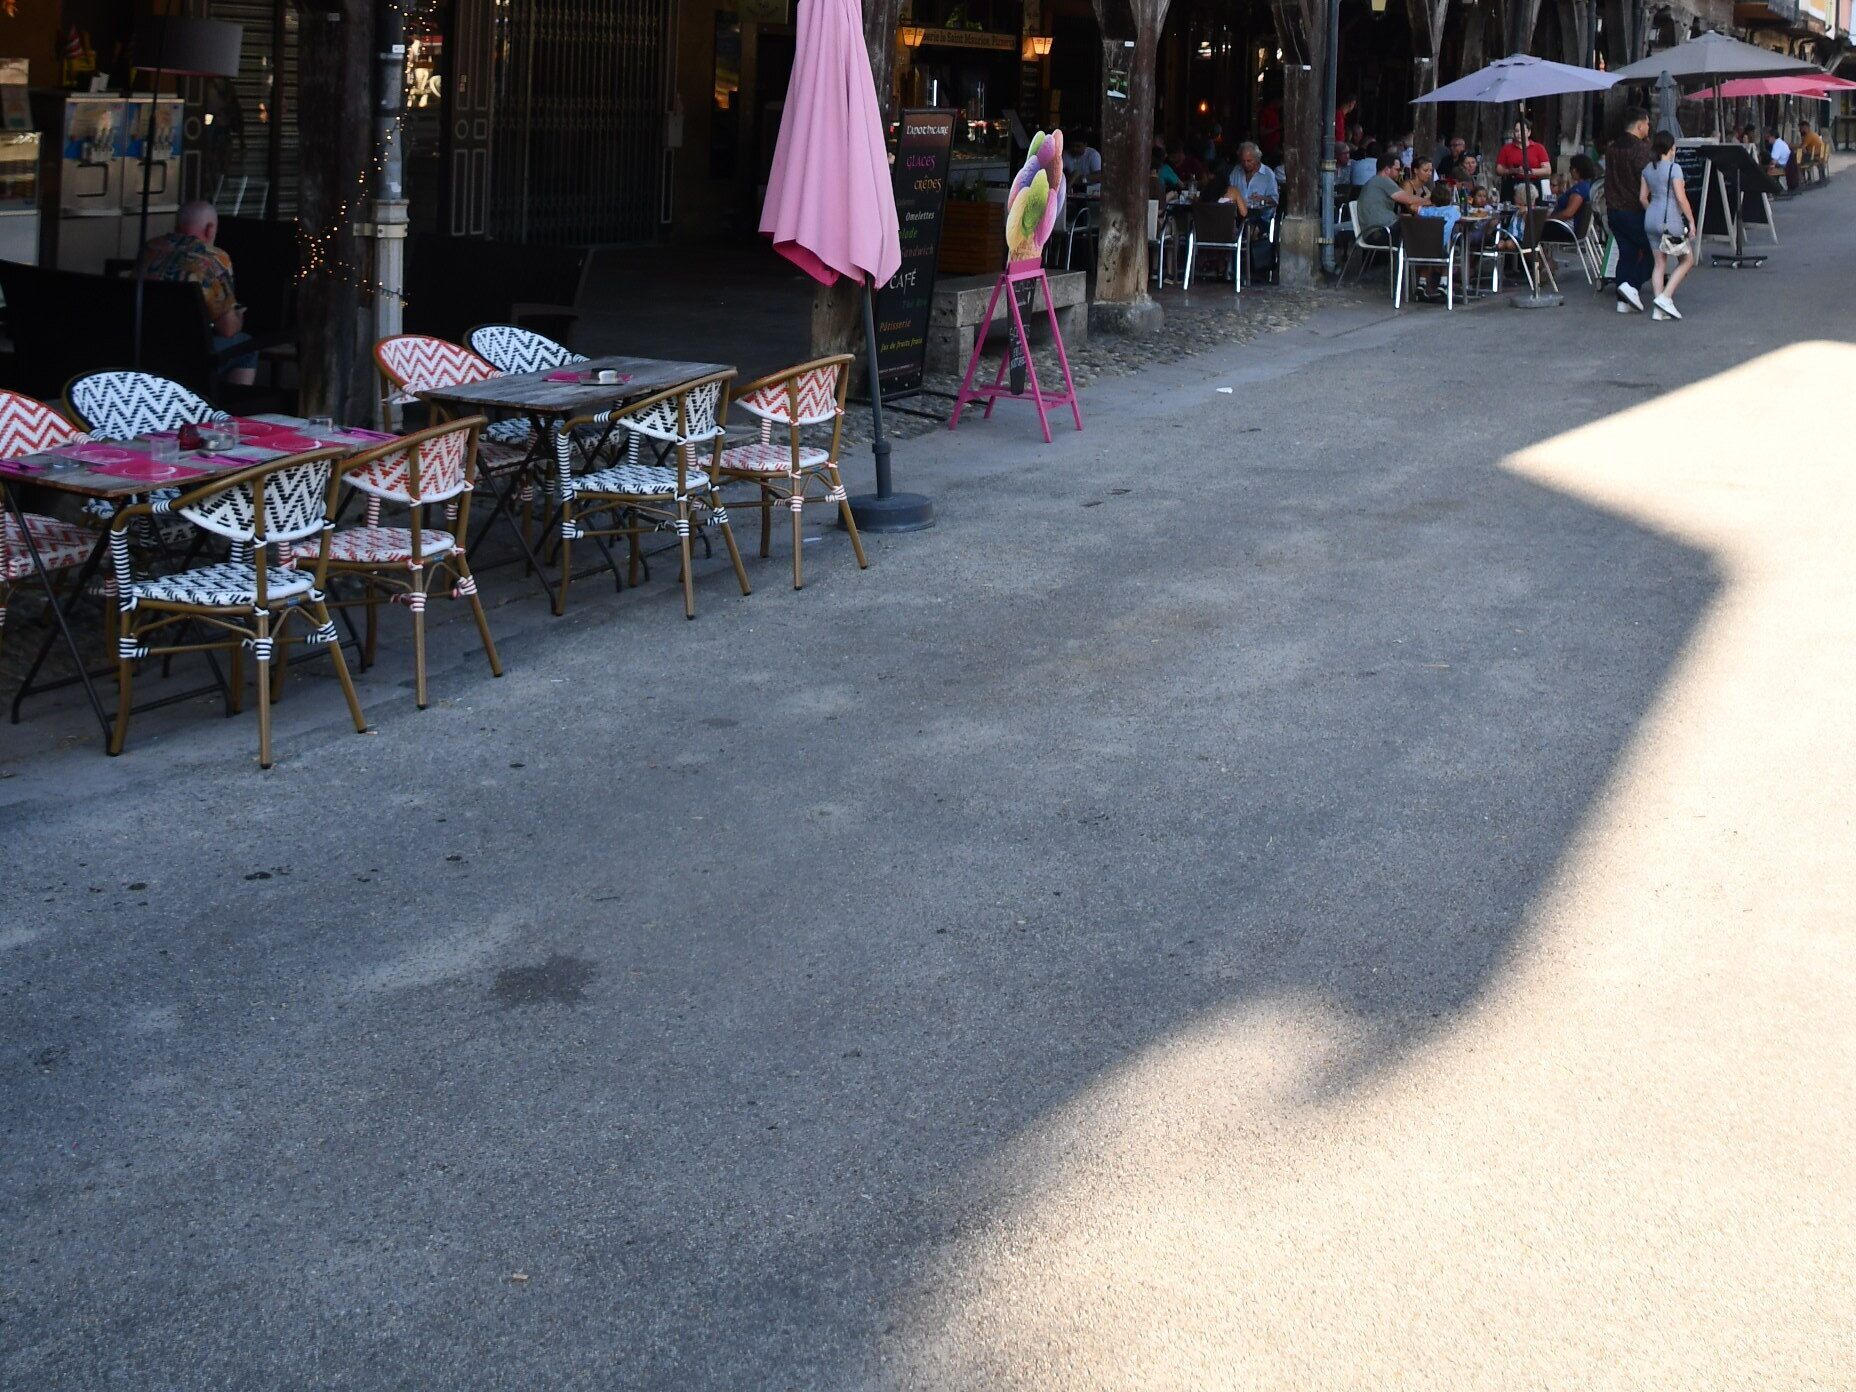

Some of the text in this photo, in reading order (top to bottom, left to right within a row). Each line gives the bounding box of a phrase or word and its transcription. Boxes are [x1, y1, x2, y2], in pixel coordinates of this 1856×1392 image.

[905, 211, 935, 221] Omelettes
[903, 243, 934, 257] andwich
[889, 268, 917, 295] CAFÉ
